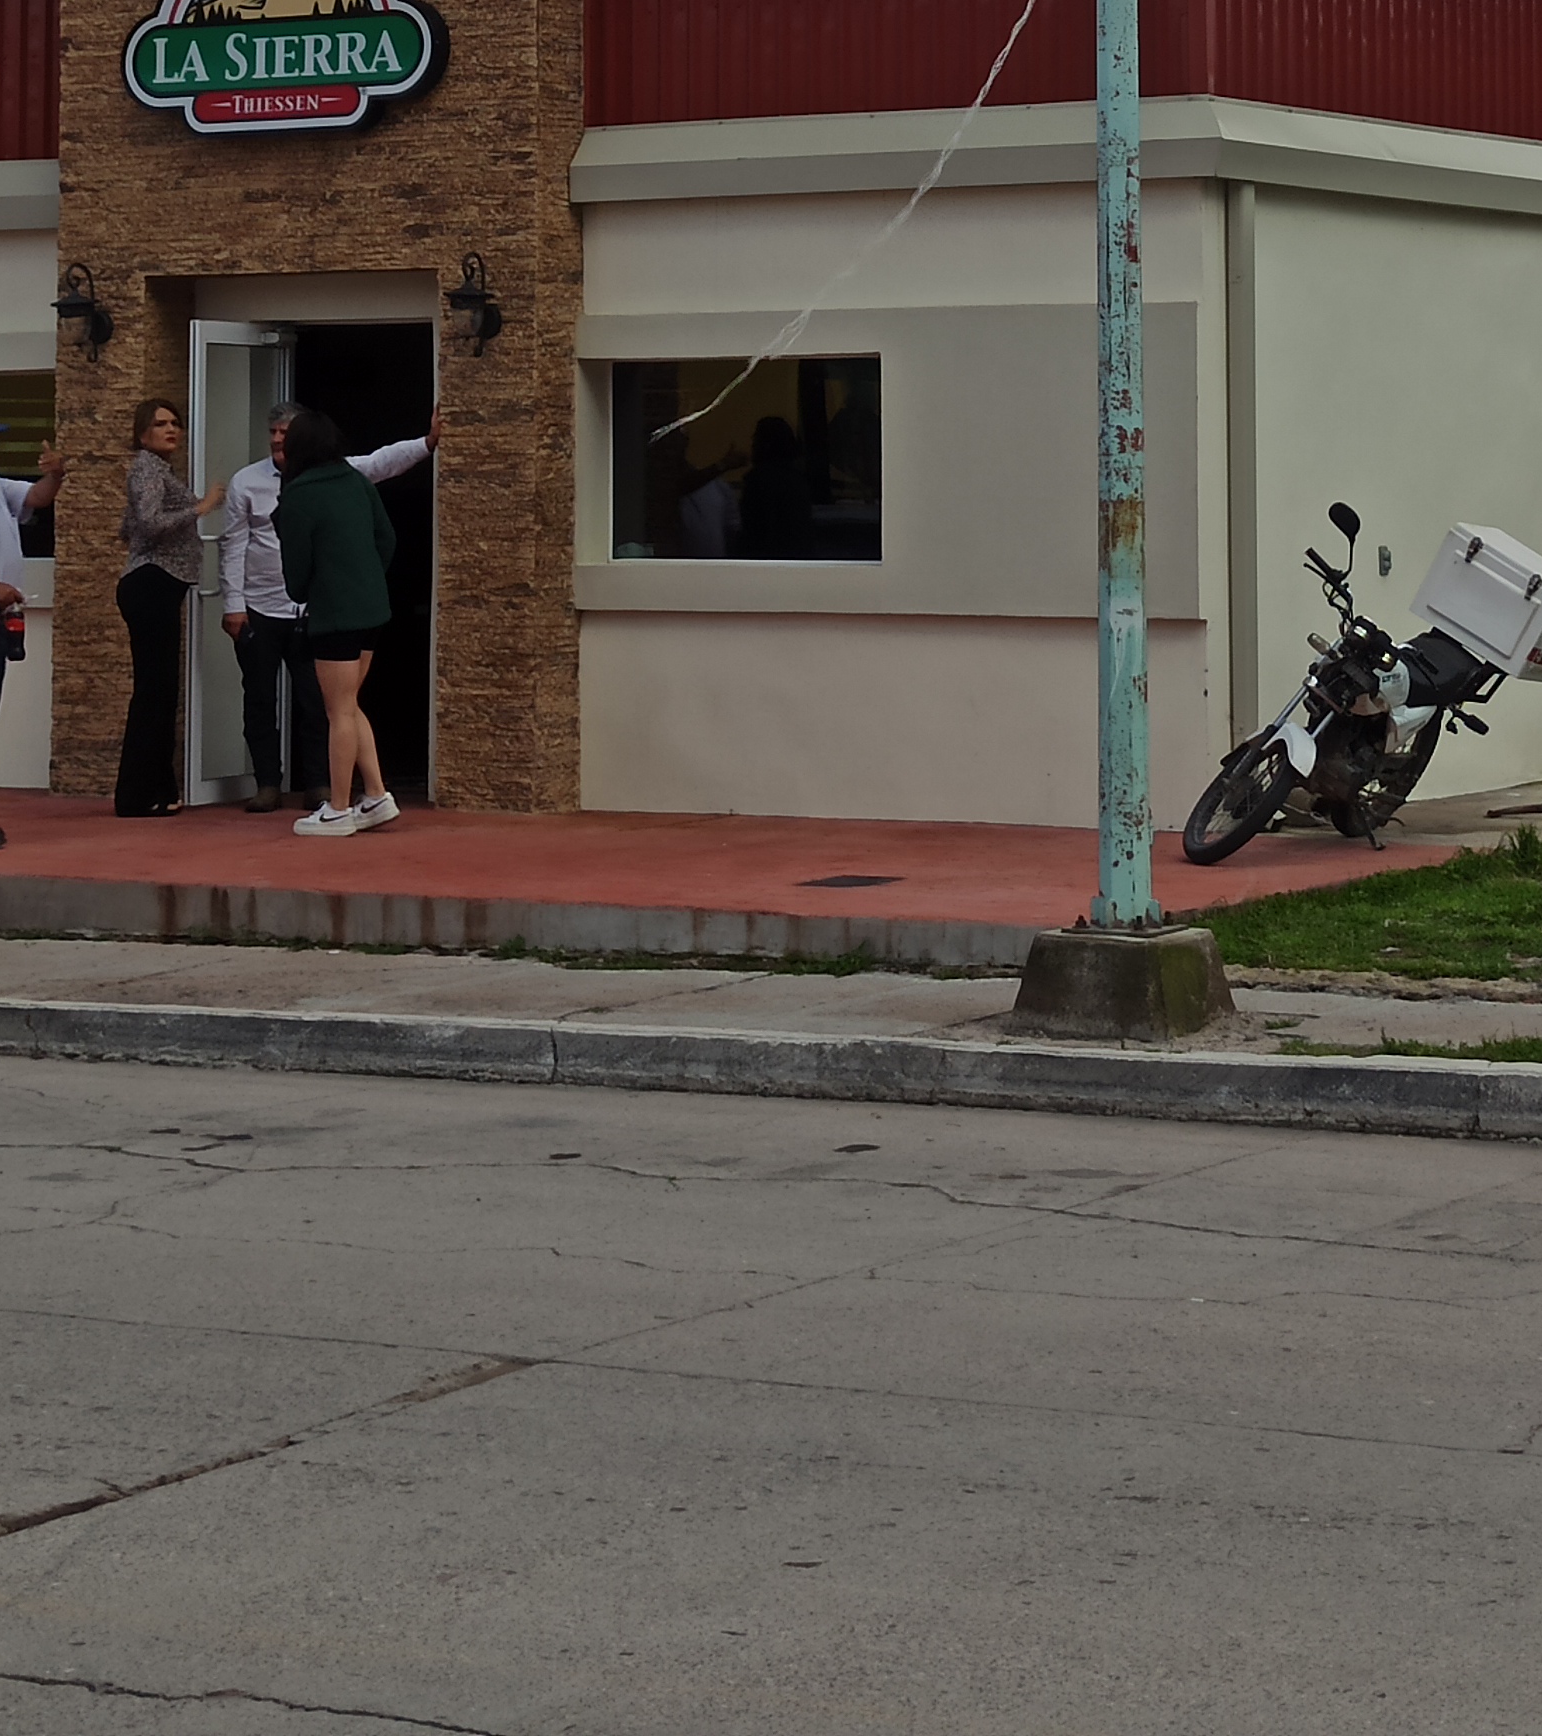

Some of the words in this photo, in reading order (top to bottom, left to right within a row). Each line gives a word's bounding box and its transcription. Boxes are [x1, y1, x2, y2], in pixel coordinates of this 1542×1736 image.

[152, 37, 209, 84] LA
[224, 29, 403, 82] SIERRA
[231, 93, 320, 115] THIESSEN
